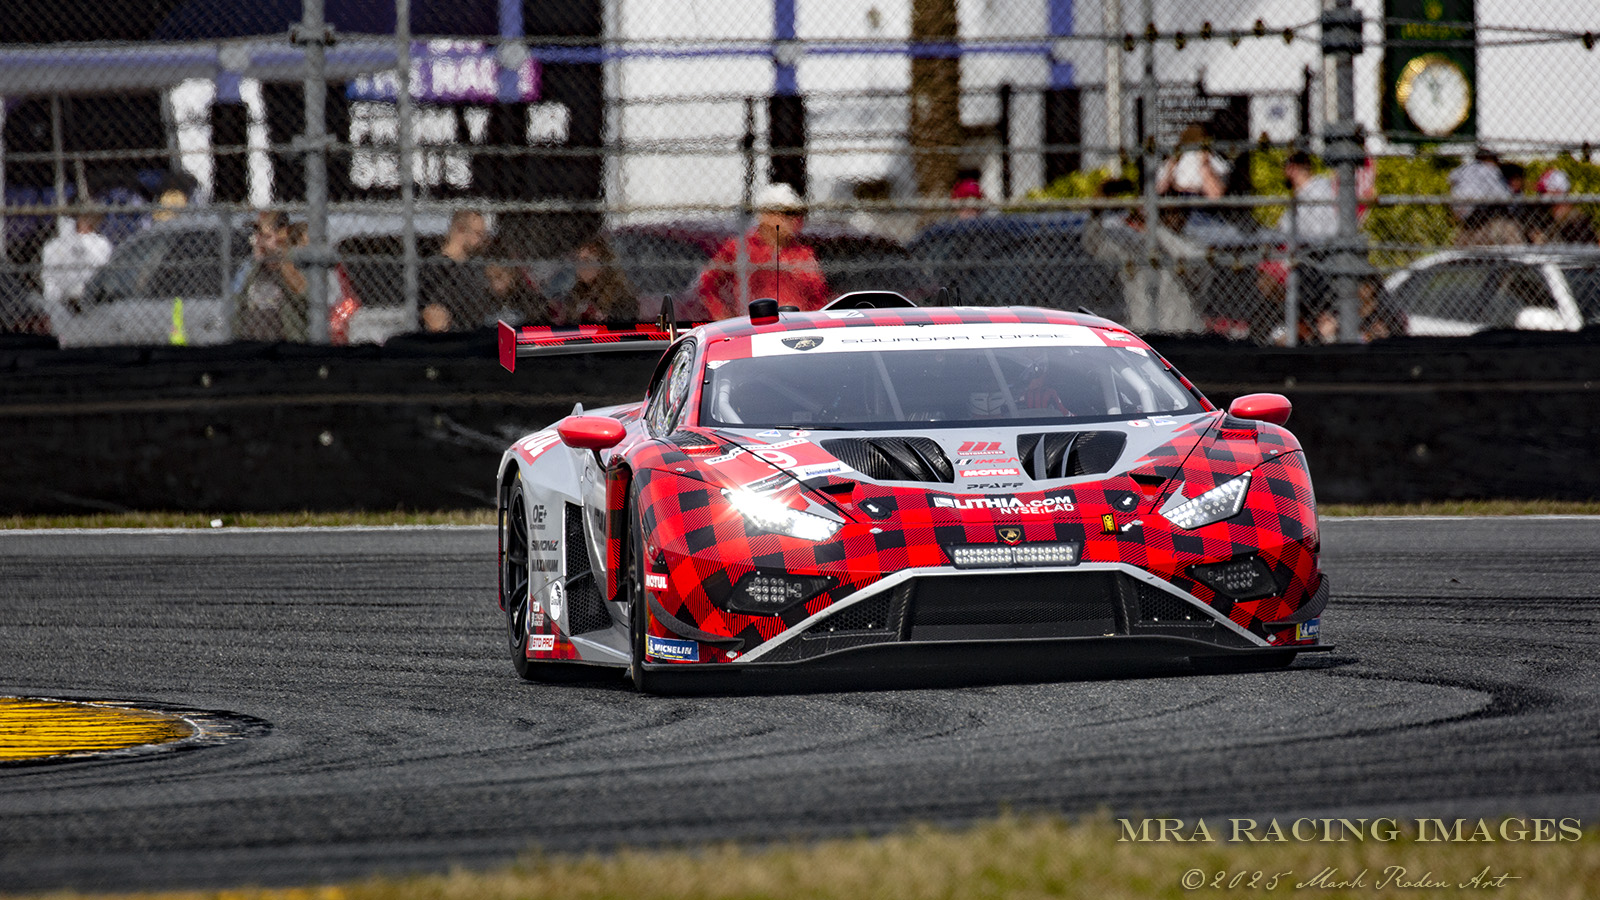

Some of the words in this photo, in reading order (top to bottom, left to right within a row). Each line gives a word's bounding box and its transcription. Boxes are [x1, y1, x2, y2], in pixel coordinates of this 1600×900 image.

[840, 335, 969, 344] SQUADRA
[981, 333, 1072, 341] CORSE
[751, 449, 798, 470] 9
[974, 457, 1019, 465] IMSA
[963, 468, 1018, 477] MOTUL
[966, 482, 1024, 490] PFAFF
[953, 495, 1072, 510] LITHIA.COM
[1000, 503, 1075, 515] NYSE:LAD
[645, 574, 668, 589] MOTUL
[542, 637, 553, 648] PRO
[654, 643, 693, 655] MICHELIN
